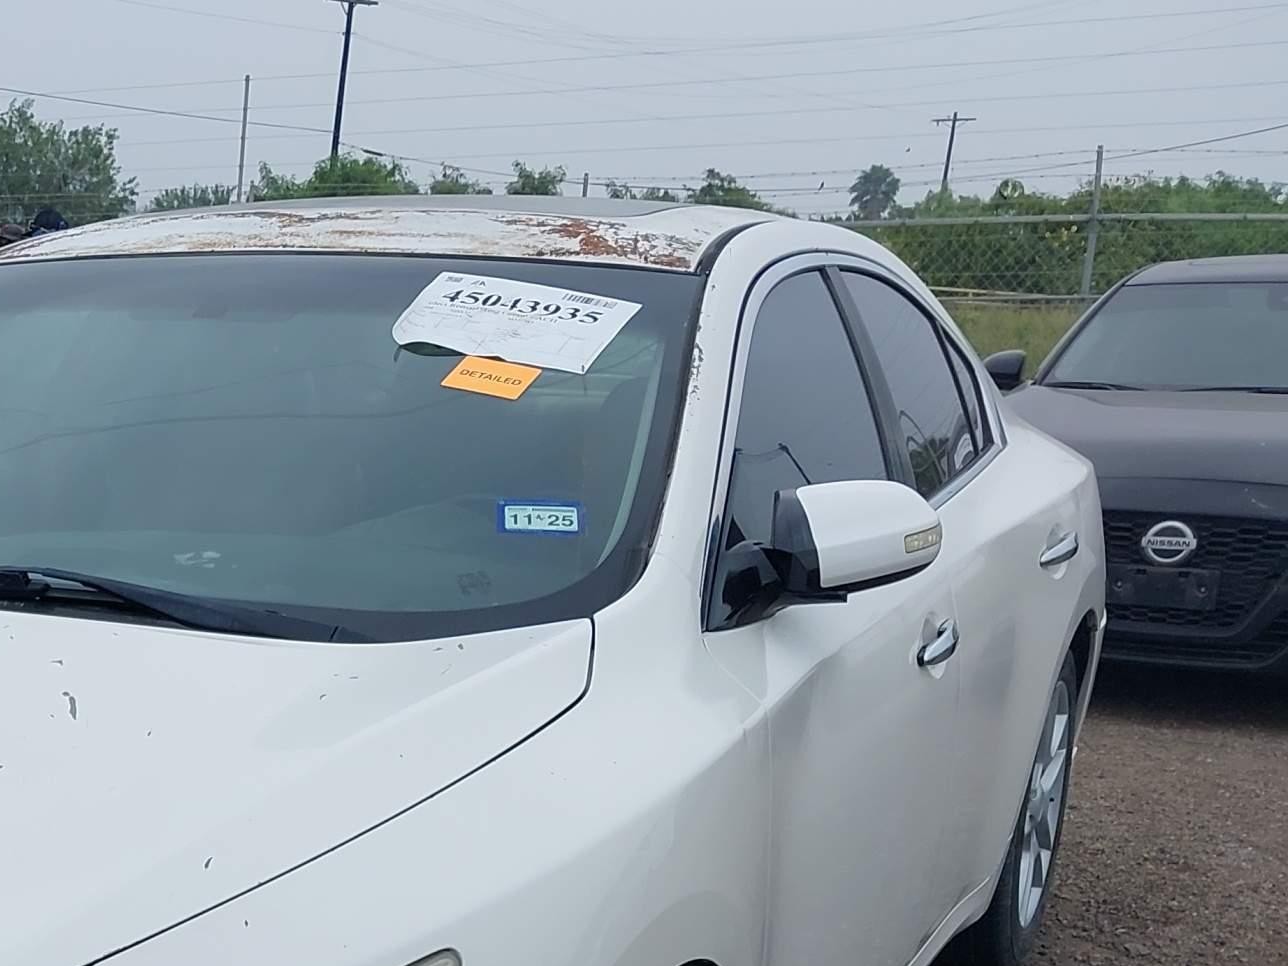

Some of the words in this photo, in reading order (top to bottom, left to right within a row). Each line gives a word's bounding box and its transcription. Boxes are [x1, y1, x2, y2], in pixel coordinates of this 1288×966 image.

[442, 288, 604, 325] 45043935
[459, 368, 523, 387] DETAILED
[509, 513, 532, 526] 11
[547, 513, 574, 527] 25
[1146, 538, 1191, 548] NISSAN
